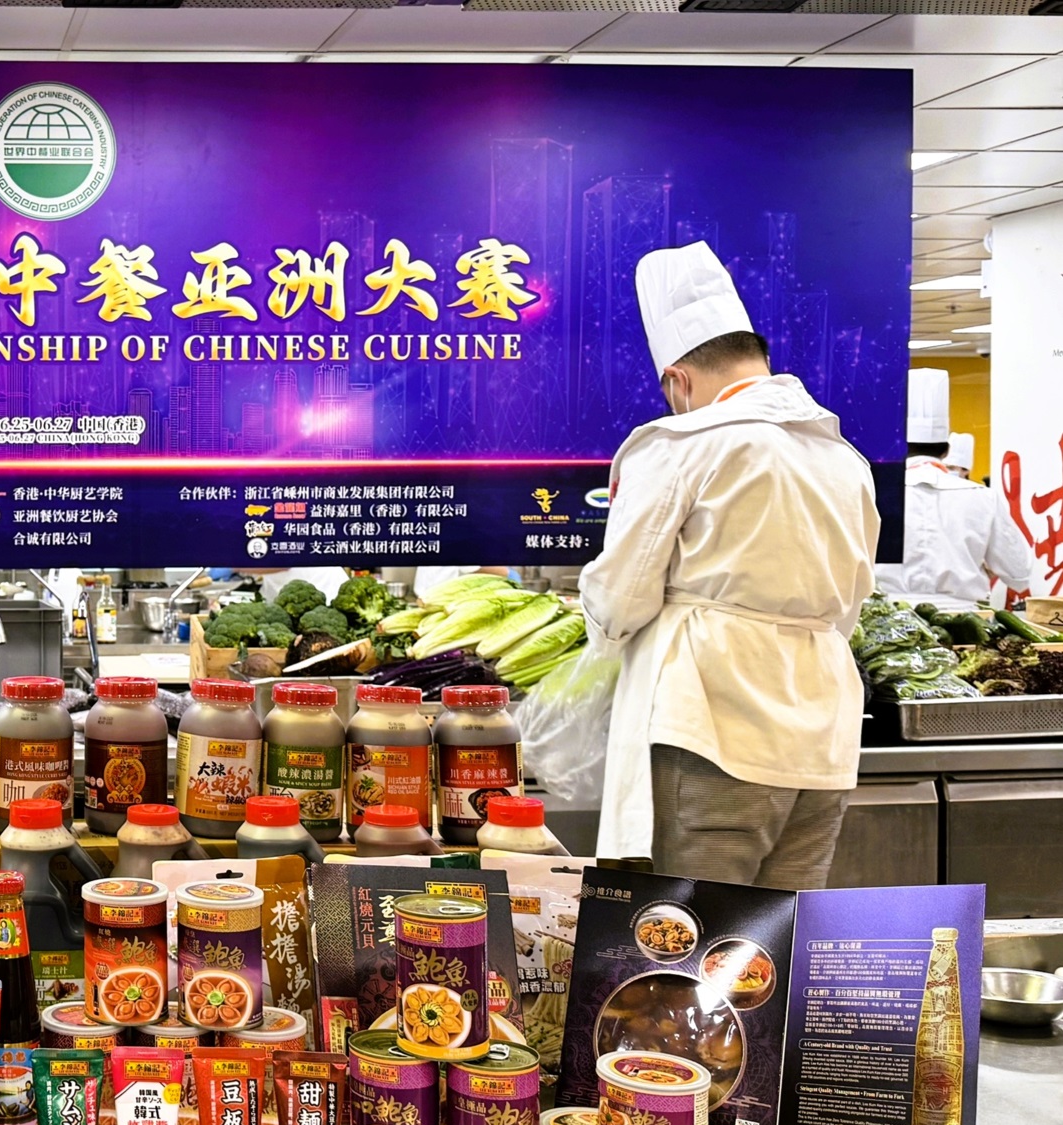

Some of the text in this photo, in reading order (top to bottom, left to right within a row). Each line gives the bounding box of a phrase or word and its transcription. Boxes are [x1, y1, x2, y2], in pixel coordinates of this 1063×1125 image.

[27, 92, 38, 101] OF
[38, 91, 71, 103] CHINESE
[72, 97, 101, 130] CATERING
[121, 334, 169, 361] OF
[183, 333, 350, 361] CHINESE
[363, 333, 522, 360] CUISINE
[77, 416, 146, 434] 中国(香港)
[13, 509, 119, 523] 亚洲餐饮厨艺协会
[13, 531, 92, 546] 合诚有限公司
[309, 540, 441, 554] 支云酒业集团有限公司
[197, 761, 226, 777] 大辣
[278, 767, 334, 780] 酸辣濃湯醬
[451, 768, 508, 780] 川香麻辣醬
[596, 887, 632, 899] 推介食譜
[111, 908, 134, 918] 李錦記
[195, 911, 219, 922] 李錦記
[358, 886, 375, 950] 紅燒元貝
[409, 923, 433, 938] 李錦記
[116, 935, 159, 966] 鮑魚
[201, 939, 246, 970] 鮑魚
[409, 948, 471, 988] 鮑魚
[855, 1044, 871, 1052] Quality
[59, 1063, 80, 1071] 李錦記
[136, 1063, 161, 1072] 李錦記
[222, 1063, 241, 1071] 李錦記
[301, 1064, 321, 1072] 李錦記
[367, 1065, 390, 1077] 李錦記
[481, 1080, 506, 1090] 李錦記
[818, 1087, 833, 1095] Quality
[135, 1096, 163, 1104] 甘辛ソース
[134, 1105, 162, 1120] 韓式
